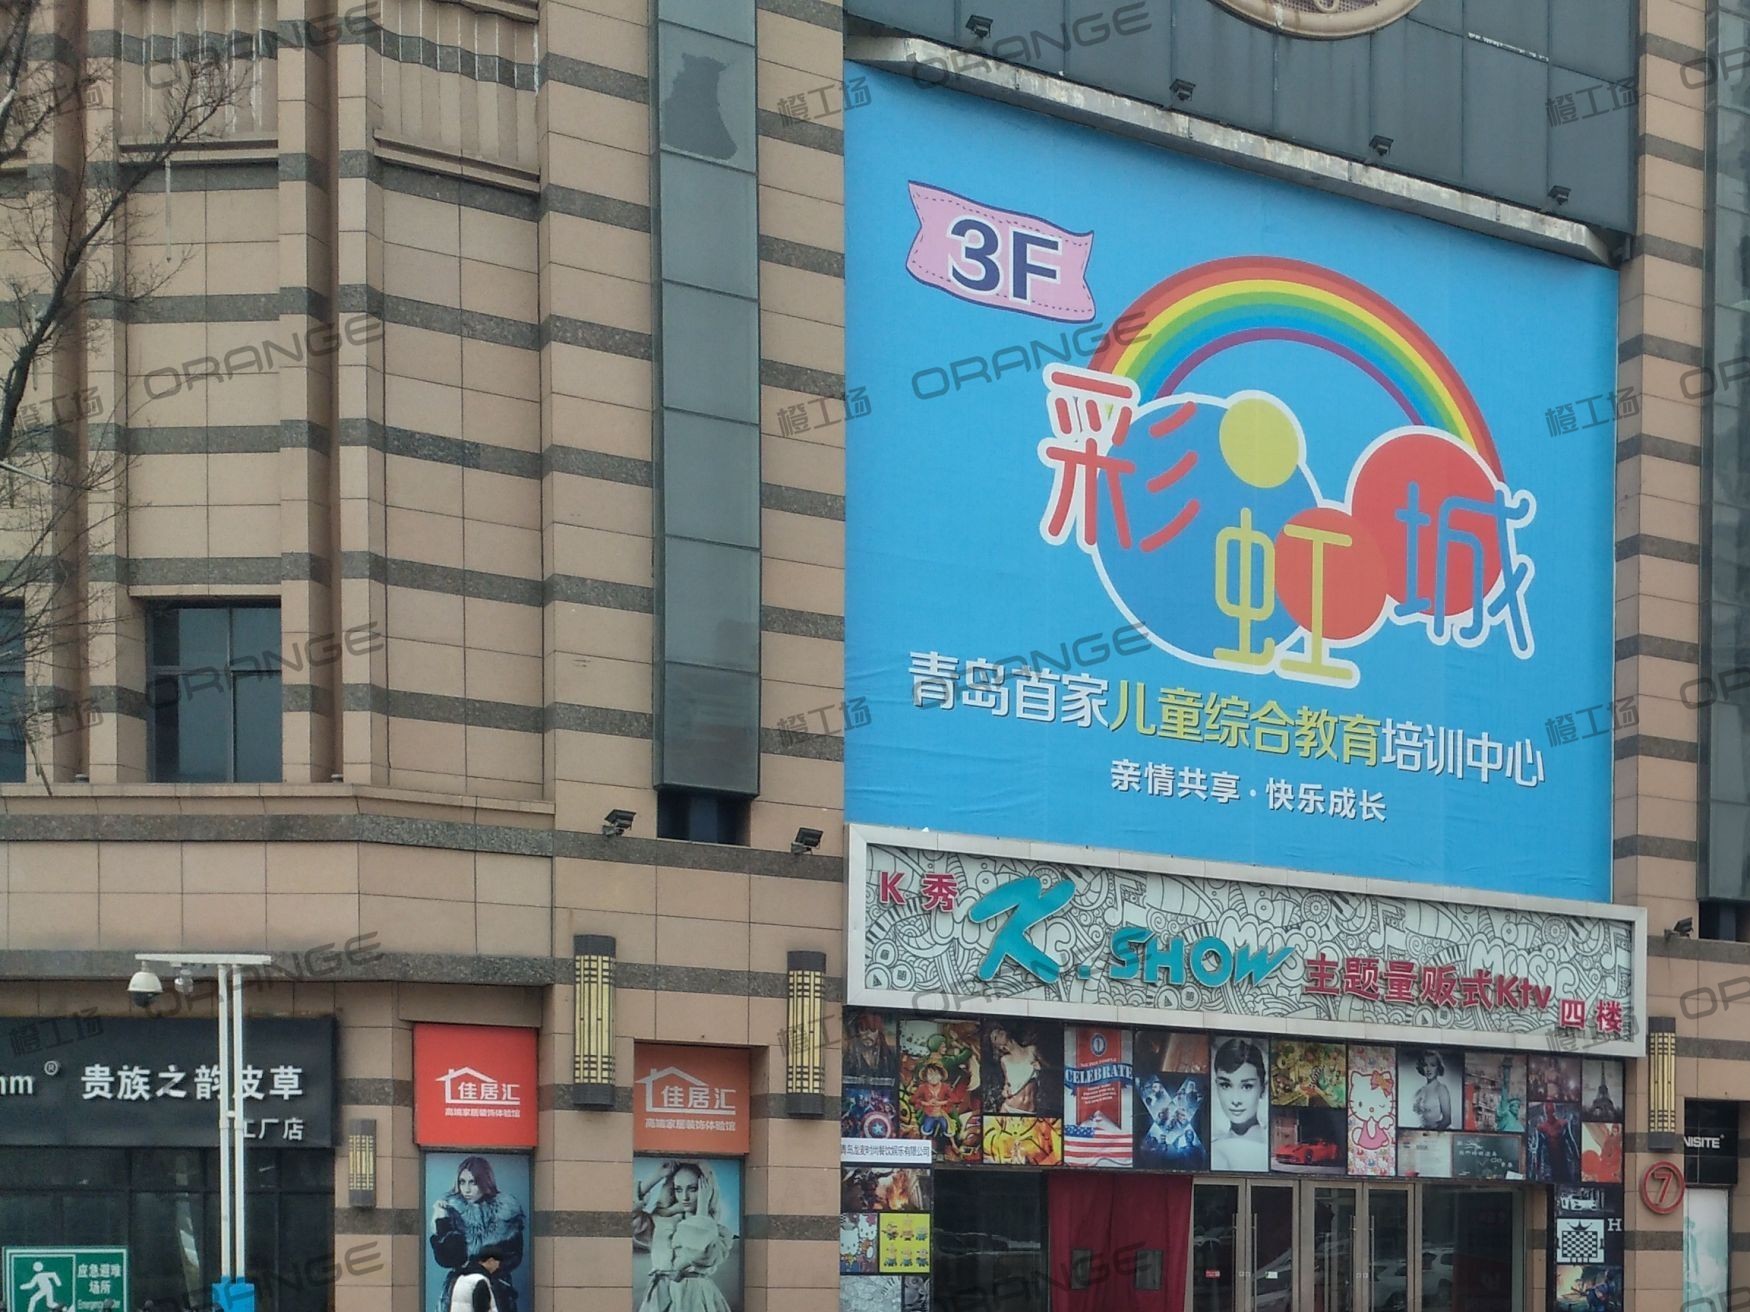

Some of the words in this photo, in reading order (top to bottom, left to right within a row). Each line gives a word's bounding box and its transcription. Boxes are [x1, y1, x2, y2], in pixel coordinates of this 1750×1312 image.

[948, 218, 1060, 302] 3F
[1044, 363, 1535, 686] 彩虹城
[909, 650, 1545, 787] 青岛首家儿童综合教育培训中心
[1302, 952, 1553, 1012] 主题量贩式Ktv
[81, 1064, 304, 1102] 贵族之韵皮草
[1065, 1064, 1133, 1084] CELEBRATE
[457, 1081, 521, 1101] 佳居汇
[661, 1085, 737, 1110] 佳居汇
[242, 1117, 304, 1141] 工厂店
[77, 1263, 122, 1279] 应急避难
[89, 1279, 112, 1296] 场所
